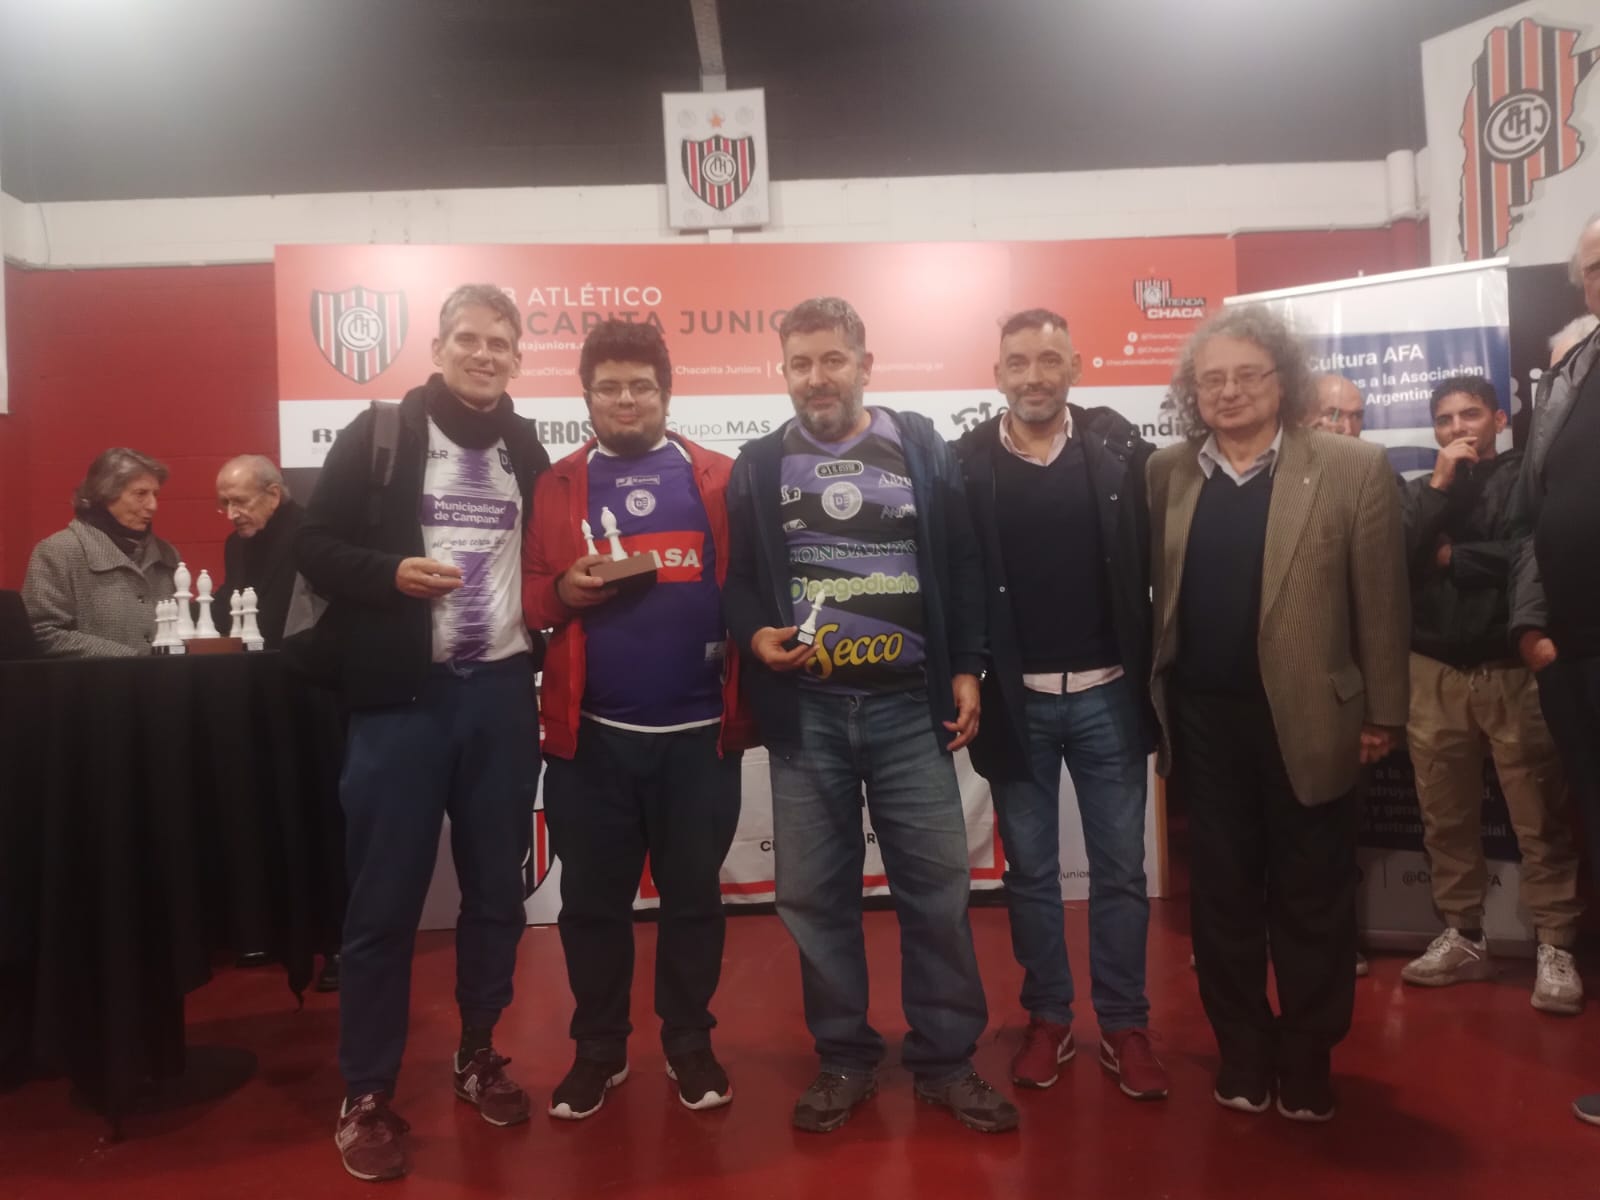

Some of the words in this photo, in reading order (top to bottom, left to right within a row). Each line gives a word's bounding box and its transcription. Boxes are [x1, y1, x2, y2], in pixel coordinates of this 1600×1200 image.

[527, 282, 662, 307] ATLÉTICO
[1146, 307, 1204, 319] CHACA
[1382, 343, 1425, 364] AFA
[1382, 373, 1397, 387] la
[667, 420, 722, 437] Grupo
[726, 420, 772, 435] MAS
[433, 500, 506, 515] Municipalidad
[433, 510, 450, 521] de
[805, 623, 904, 680] Secco
